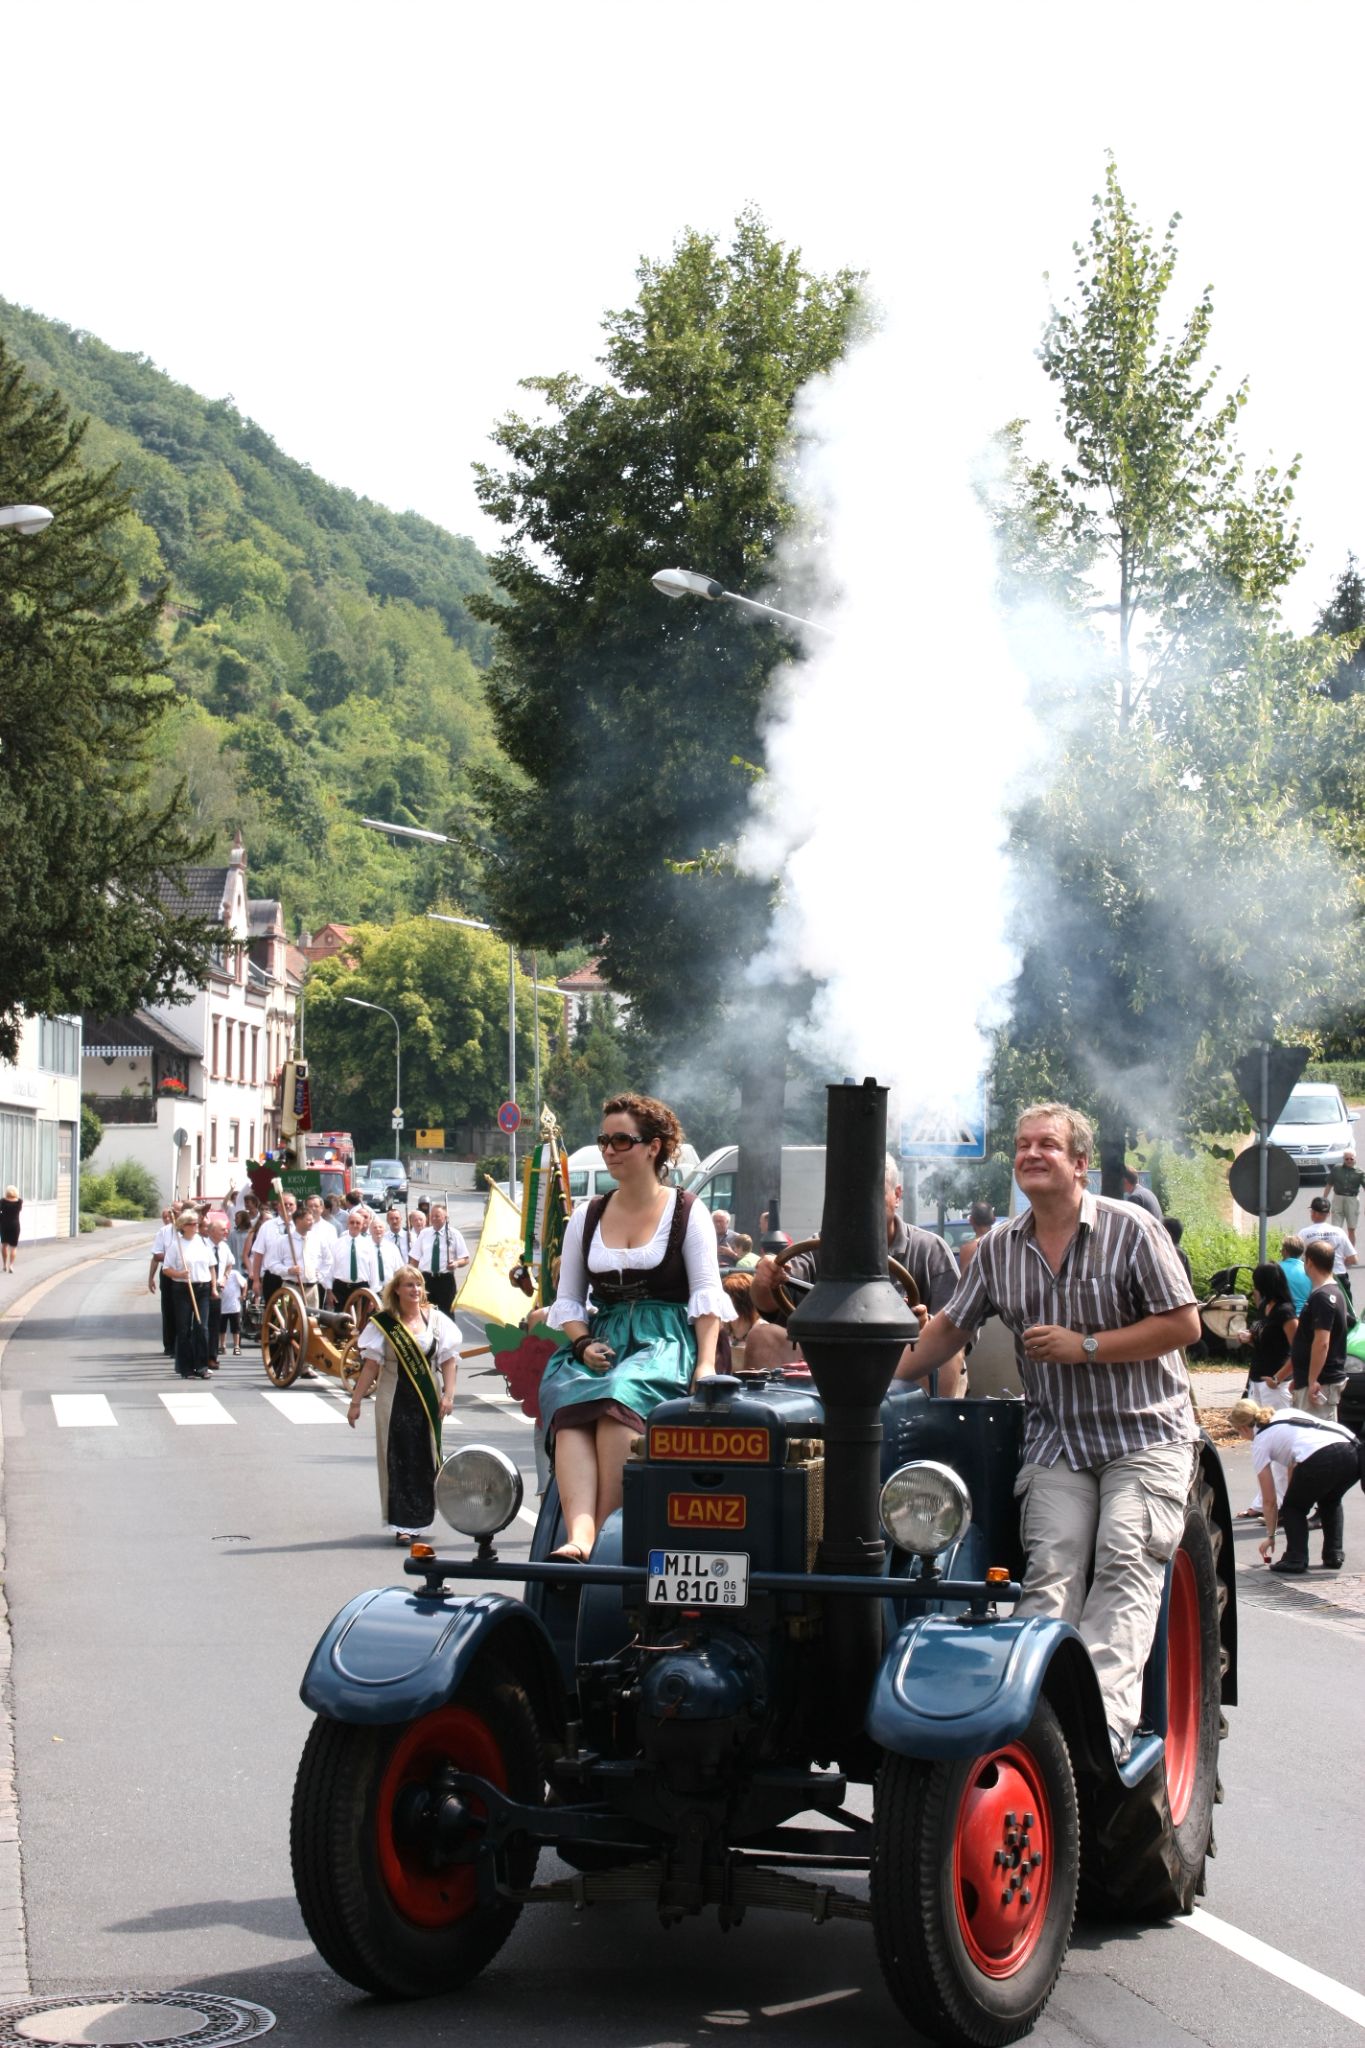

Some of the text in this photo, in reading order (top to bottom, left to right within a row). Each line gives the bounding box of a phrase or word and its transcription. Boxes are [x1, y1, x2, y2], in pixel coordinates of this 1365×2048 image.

[654, 1431, 763, 1456] BULLDOG
[673, 1499, 740, 1523] LANZ
[665, 1554, 709, 1577] MIL
[655, 1580, 718, 1603] A 810
[723, 1580, 736, 1590] 06
[723, 1594, 736, 1604] 09
